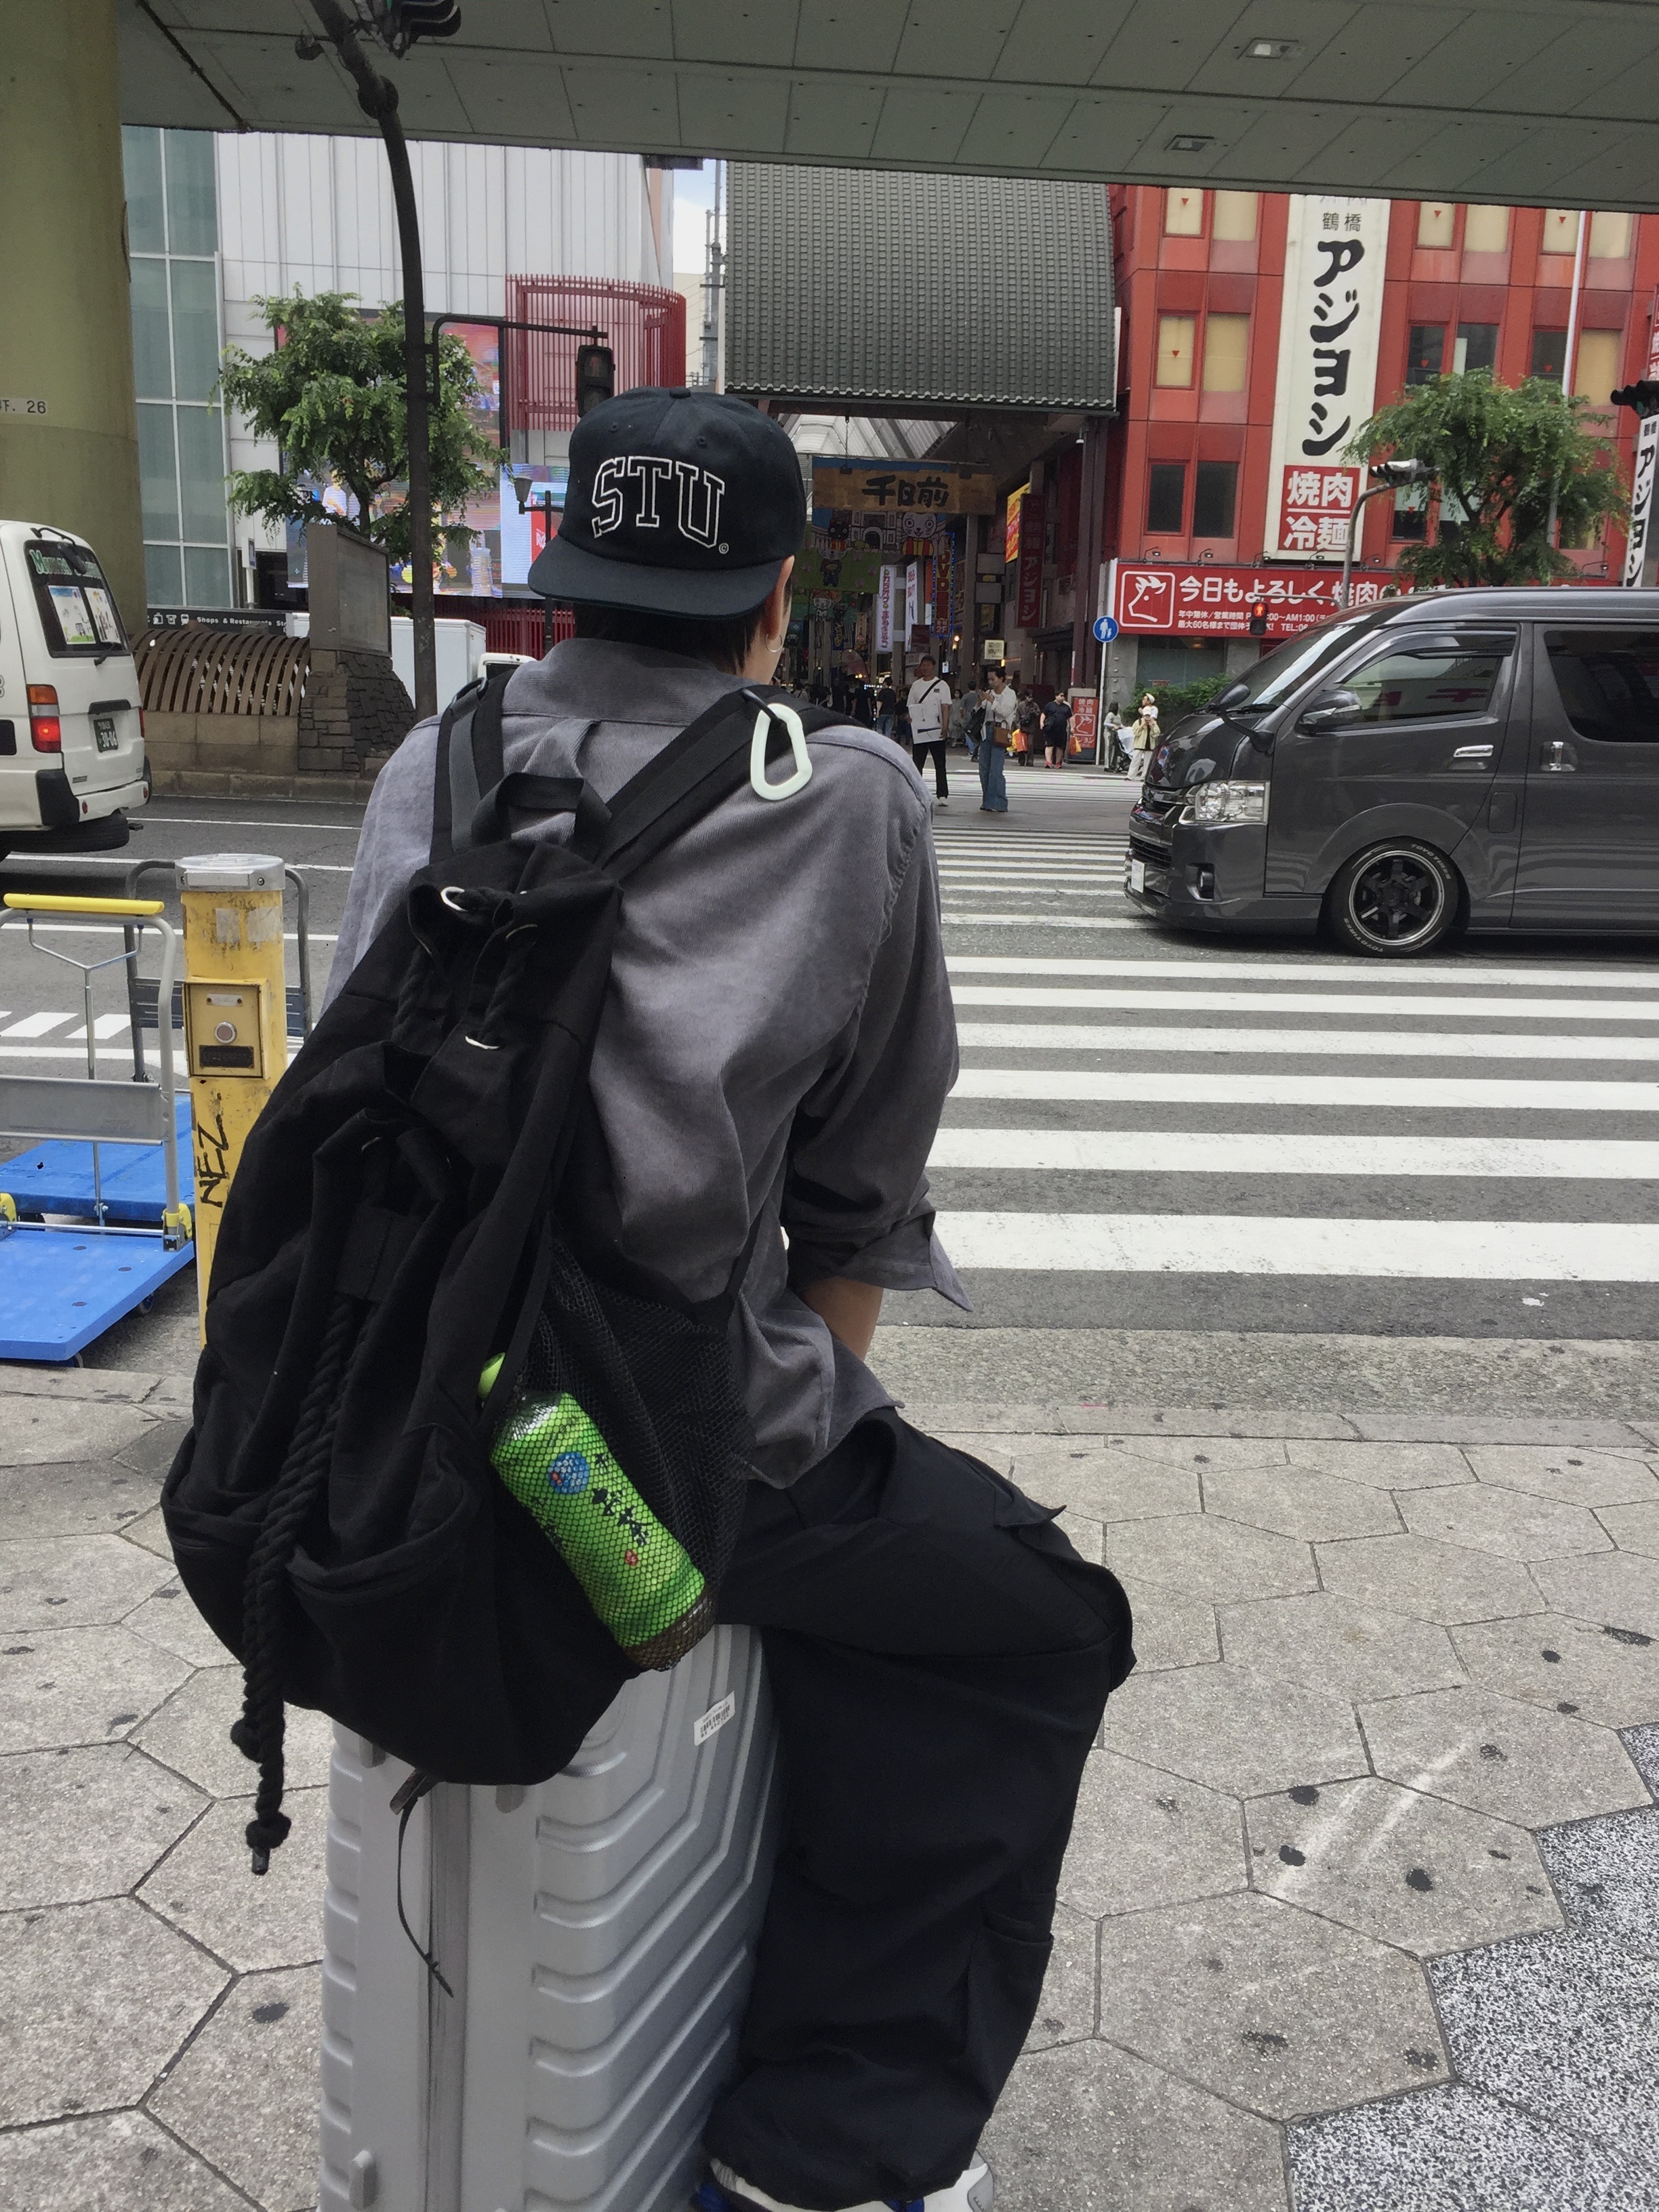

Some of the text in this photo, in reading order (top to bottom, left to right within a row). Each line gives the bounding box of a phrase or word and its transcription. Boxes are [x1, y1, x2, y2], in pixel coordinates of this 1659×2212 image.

[1322, 211, 1363, 232] 鶴橋
[26, 400, 46, 414] 26
[861, 474, 949, 508] 千日前
[1286, 470, 1353, 508] 焼肉
[591, 455, 725, 549] STU
[1283, 515, 1351, 551] 冷麺
[197, 616, 219, 624] Shops
[1411, 844, 1435, 857] TOYO
[1360, 940, 1384, 953] TOYO
